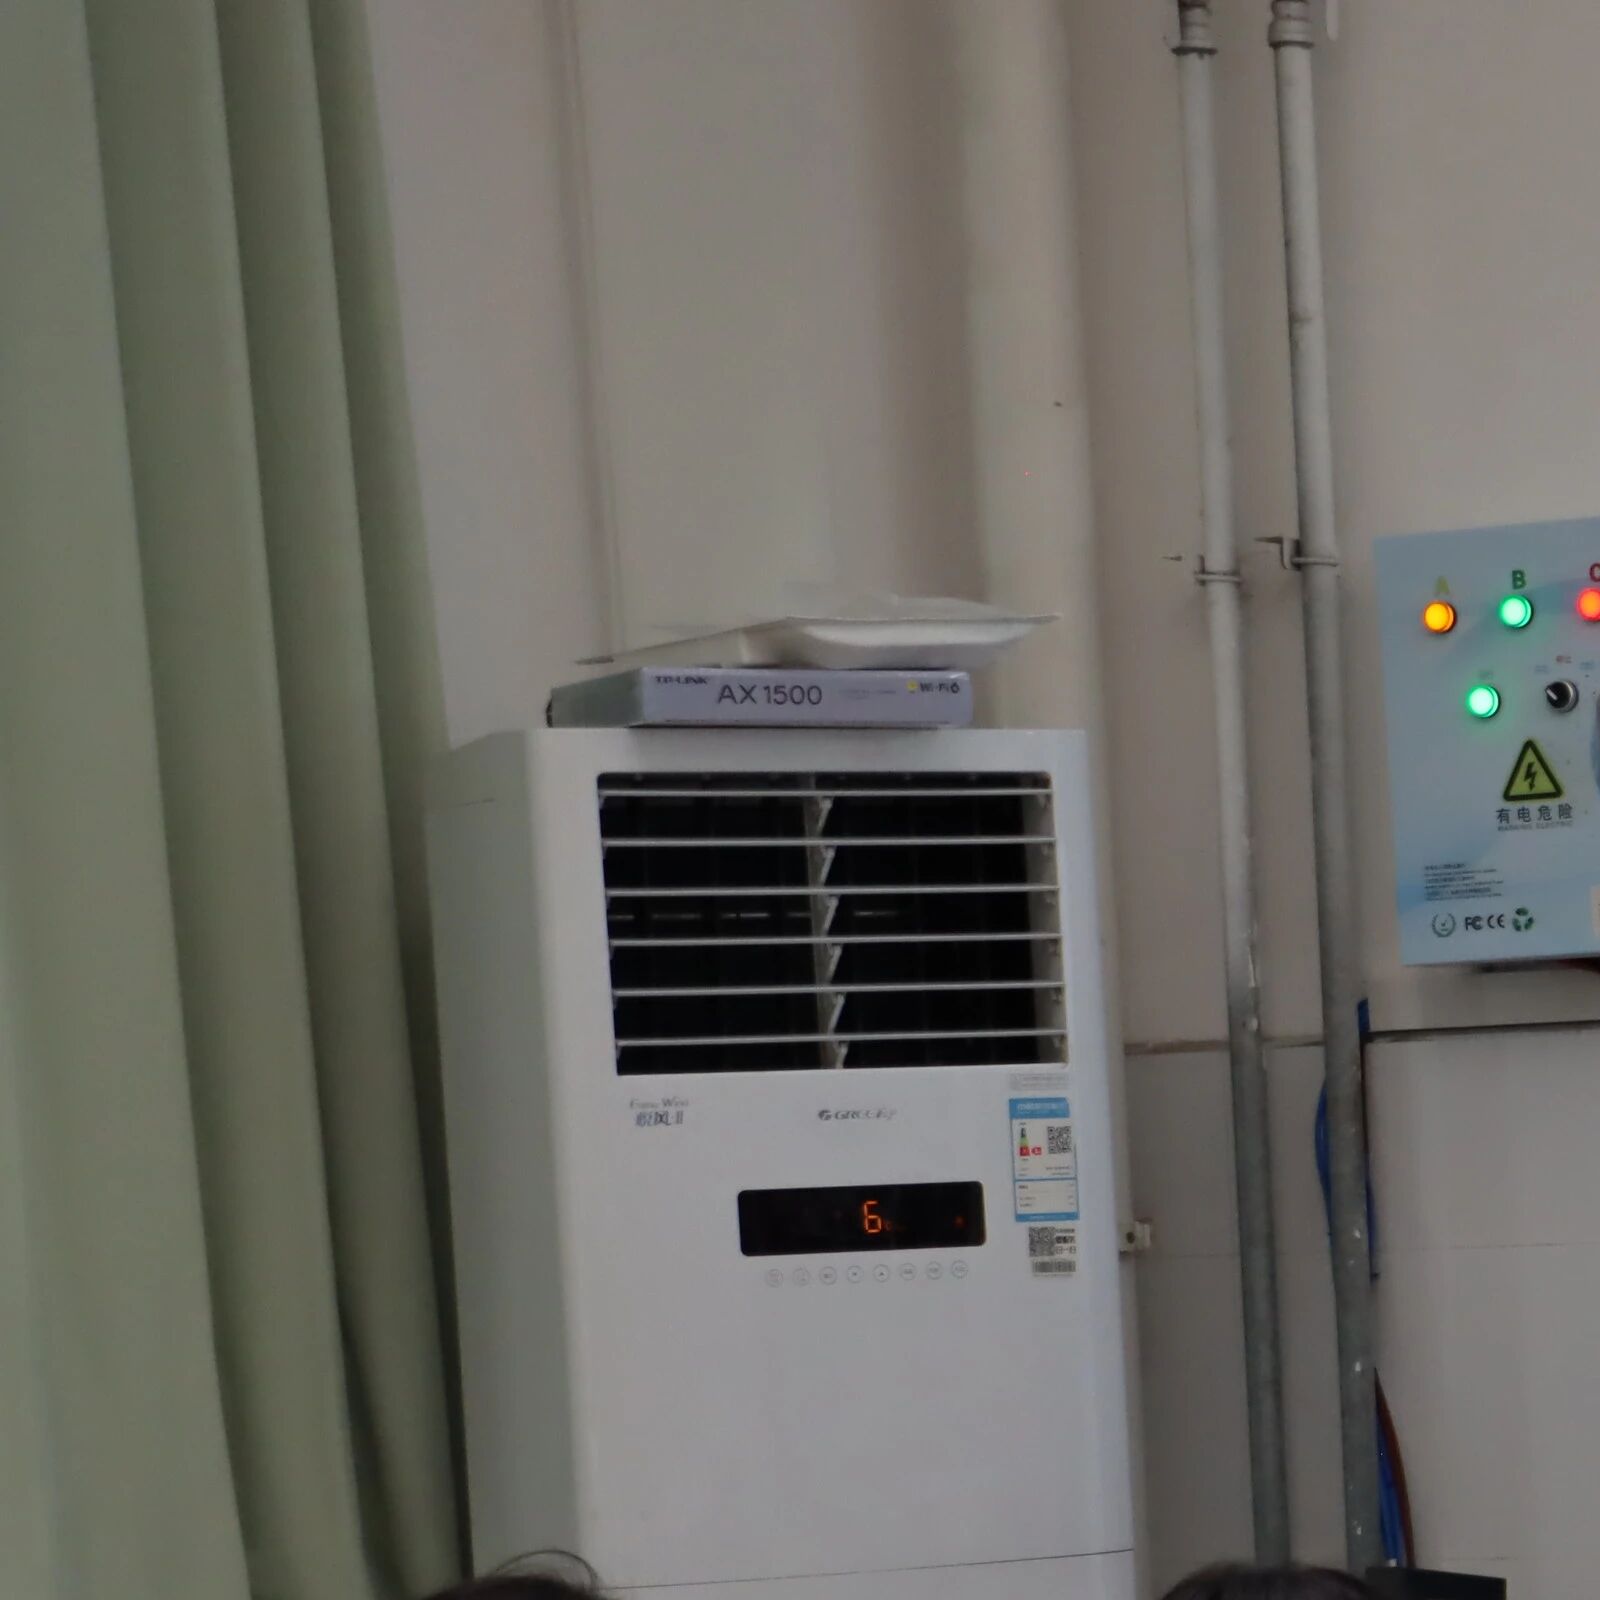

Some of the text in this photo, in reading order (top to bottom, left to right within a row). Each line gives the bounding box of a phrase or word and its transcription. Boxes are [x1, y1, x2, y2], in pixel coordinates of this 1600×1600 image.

[1434, 576, 1450, 595] A
[1511, 570, 1527, 589] B
[1496, 803, 1573, 824] 有电危险
[863, 1200, 882, 1233] 6
